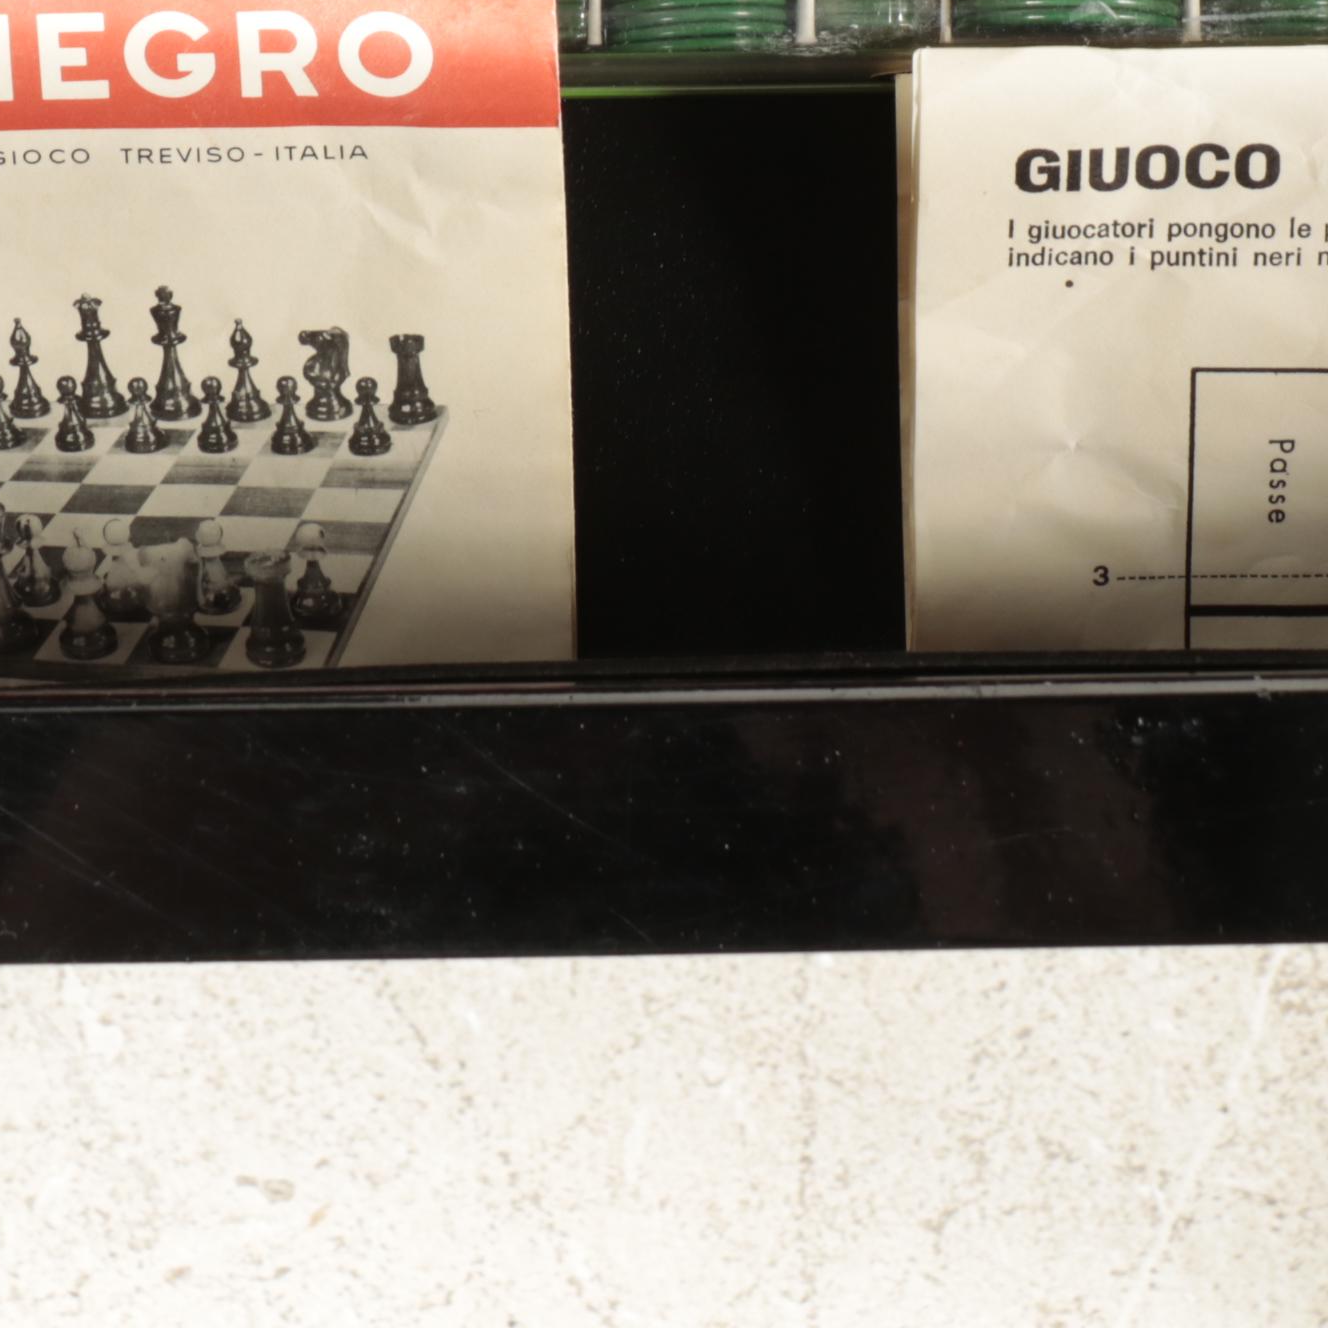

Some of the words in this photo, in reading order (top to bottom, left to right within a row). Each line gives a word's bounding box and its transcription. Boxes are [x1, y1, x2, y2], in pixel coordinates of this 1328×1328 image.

[1014, 142, 1281, 194] GIUOCO
[1027, 217, 1155, 241] giuocatori
[1167, 222, 1276, 244] pongono
[1289, 216, 1312, 239] le
[1008, 247, 1114, 267] indicano
[1150, 246, 1238, 271] puntini
[1253, 247, 1302, 267] neri
[1266, 439, 1295, 525] Passe
[1092, 565, 1110, 587] 3
